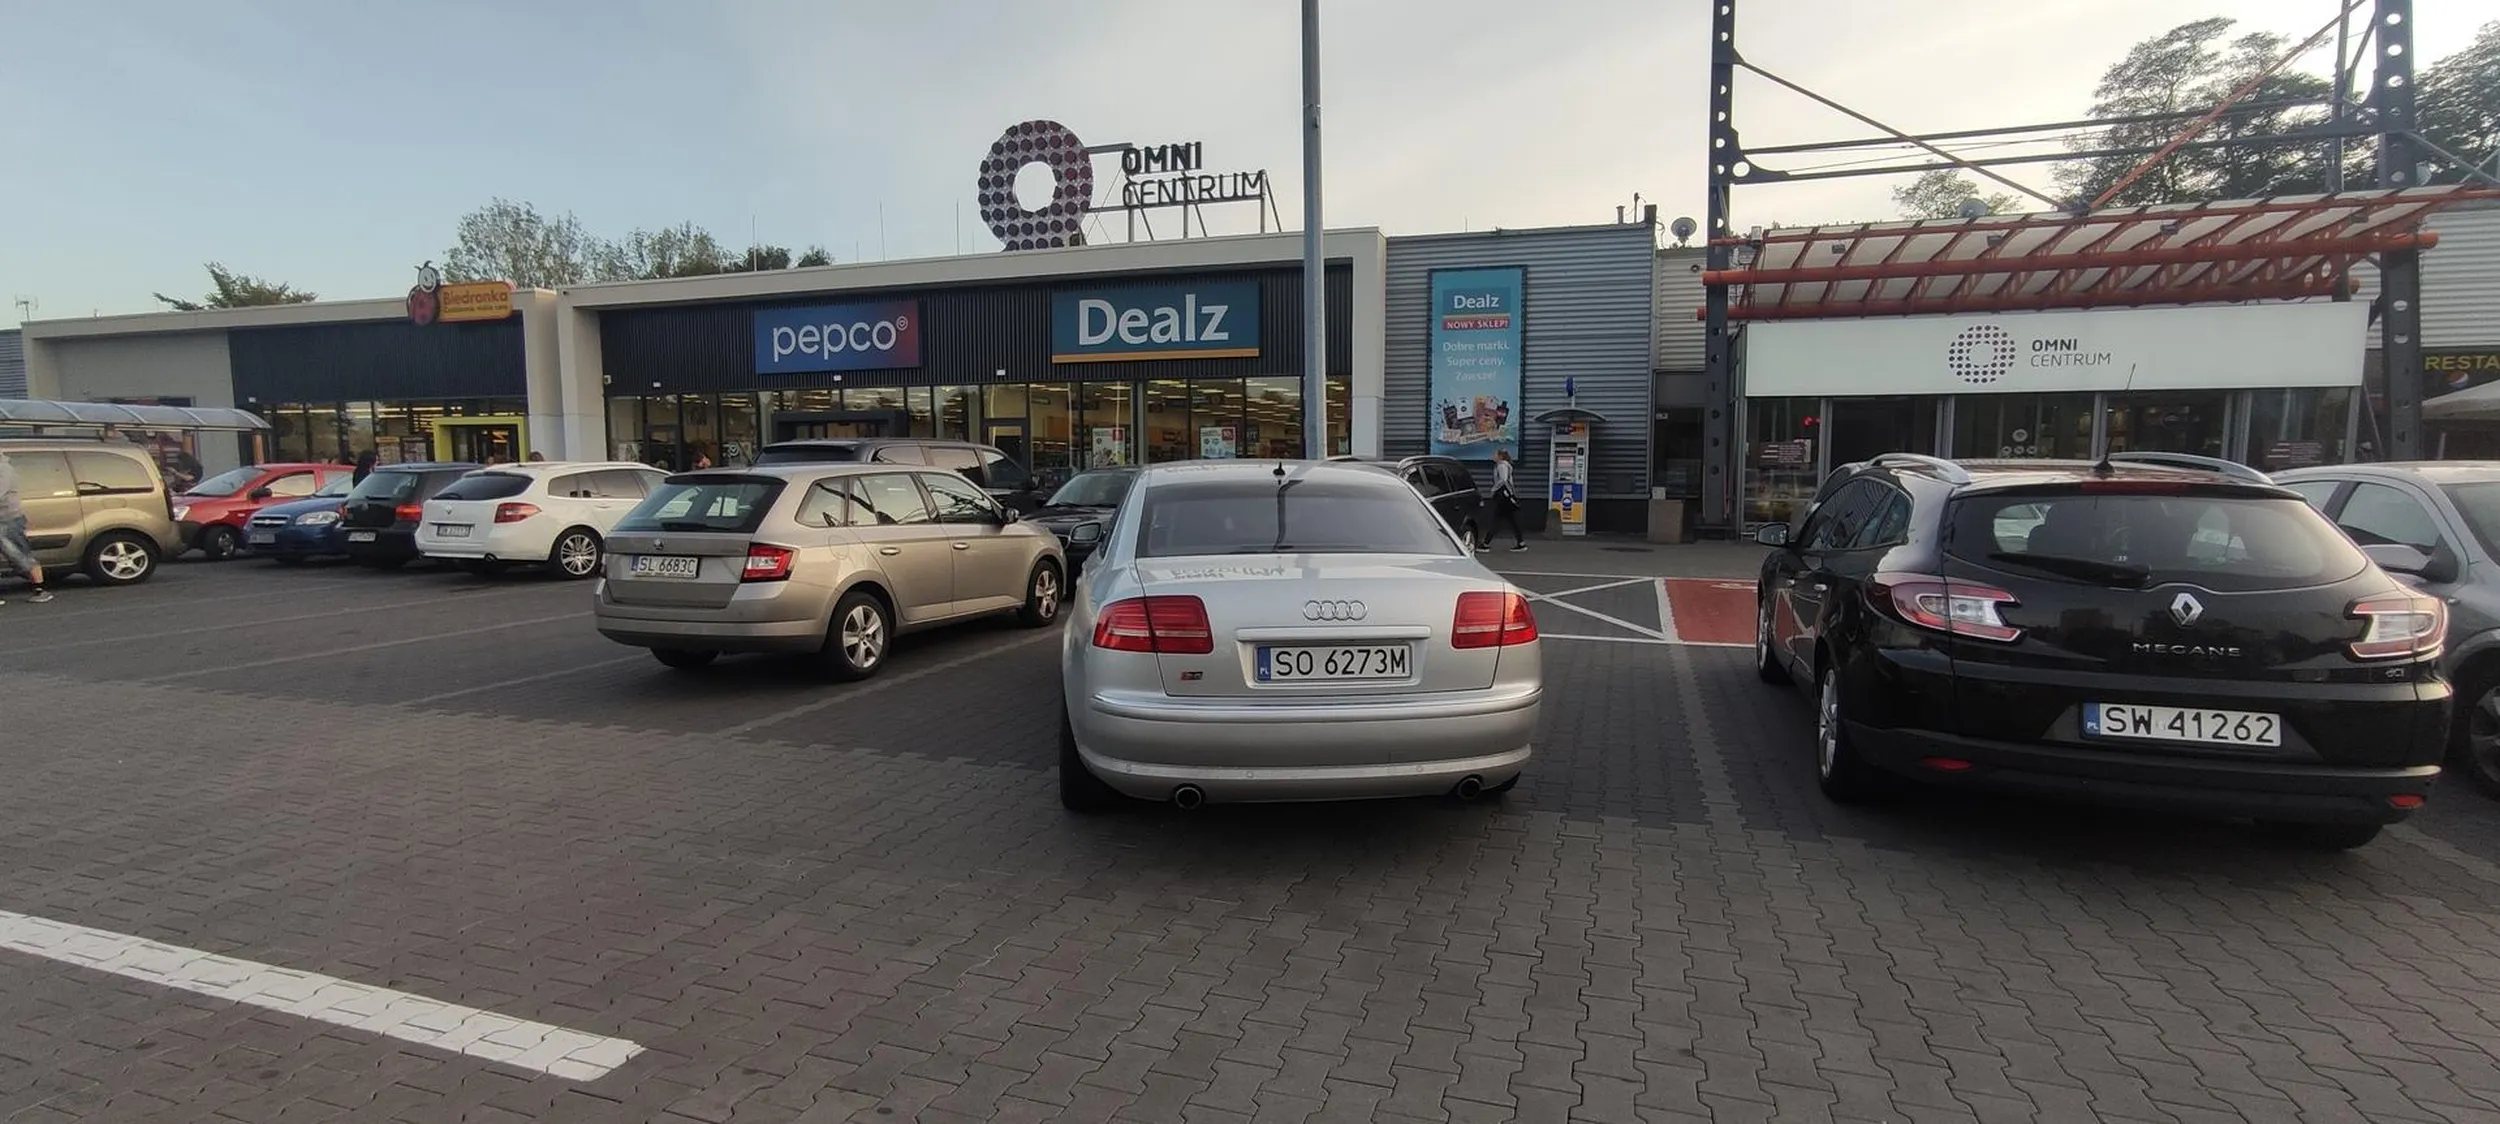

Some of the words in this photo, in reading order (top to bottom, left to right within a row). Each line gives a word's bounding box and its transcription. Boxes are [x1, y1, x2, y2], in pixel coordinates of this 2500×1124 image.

[1122, 141, 1202, 175] OMNI
[1123, 170, 1264, 207] CENTRUM
[443, 290, 507, 305] Biedronka
[1453, 294, 1500, 309] Dealz
[1079, 294, 1229, 345] Dealz
[1446, 321, 1474, 329] NOWY
[773, 320, 896, 362] pepco
[1443, 341, 1475, 351] Dobre
[2031, 339, 2077, 352] OMNI
[1447, 357, 1477, 367] Super
[2030, 352, 2111, 367] CENTRUM
[2424, 354, 2500, 370] RESTA
[639, 557, 654, 571] SL
[2132, 643, 2240, 657] MEGANE
[1276, 650, 1313, 676] SO
[1325, 649, 1406, 676] 6273M
[2105, 707, 2153, 735] SW
[2167, 711, 2274, 743] 41262
